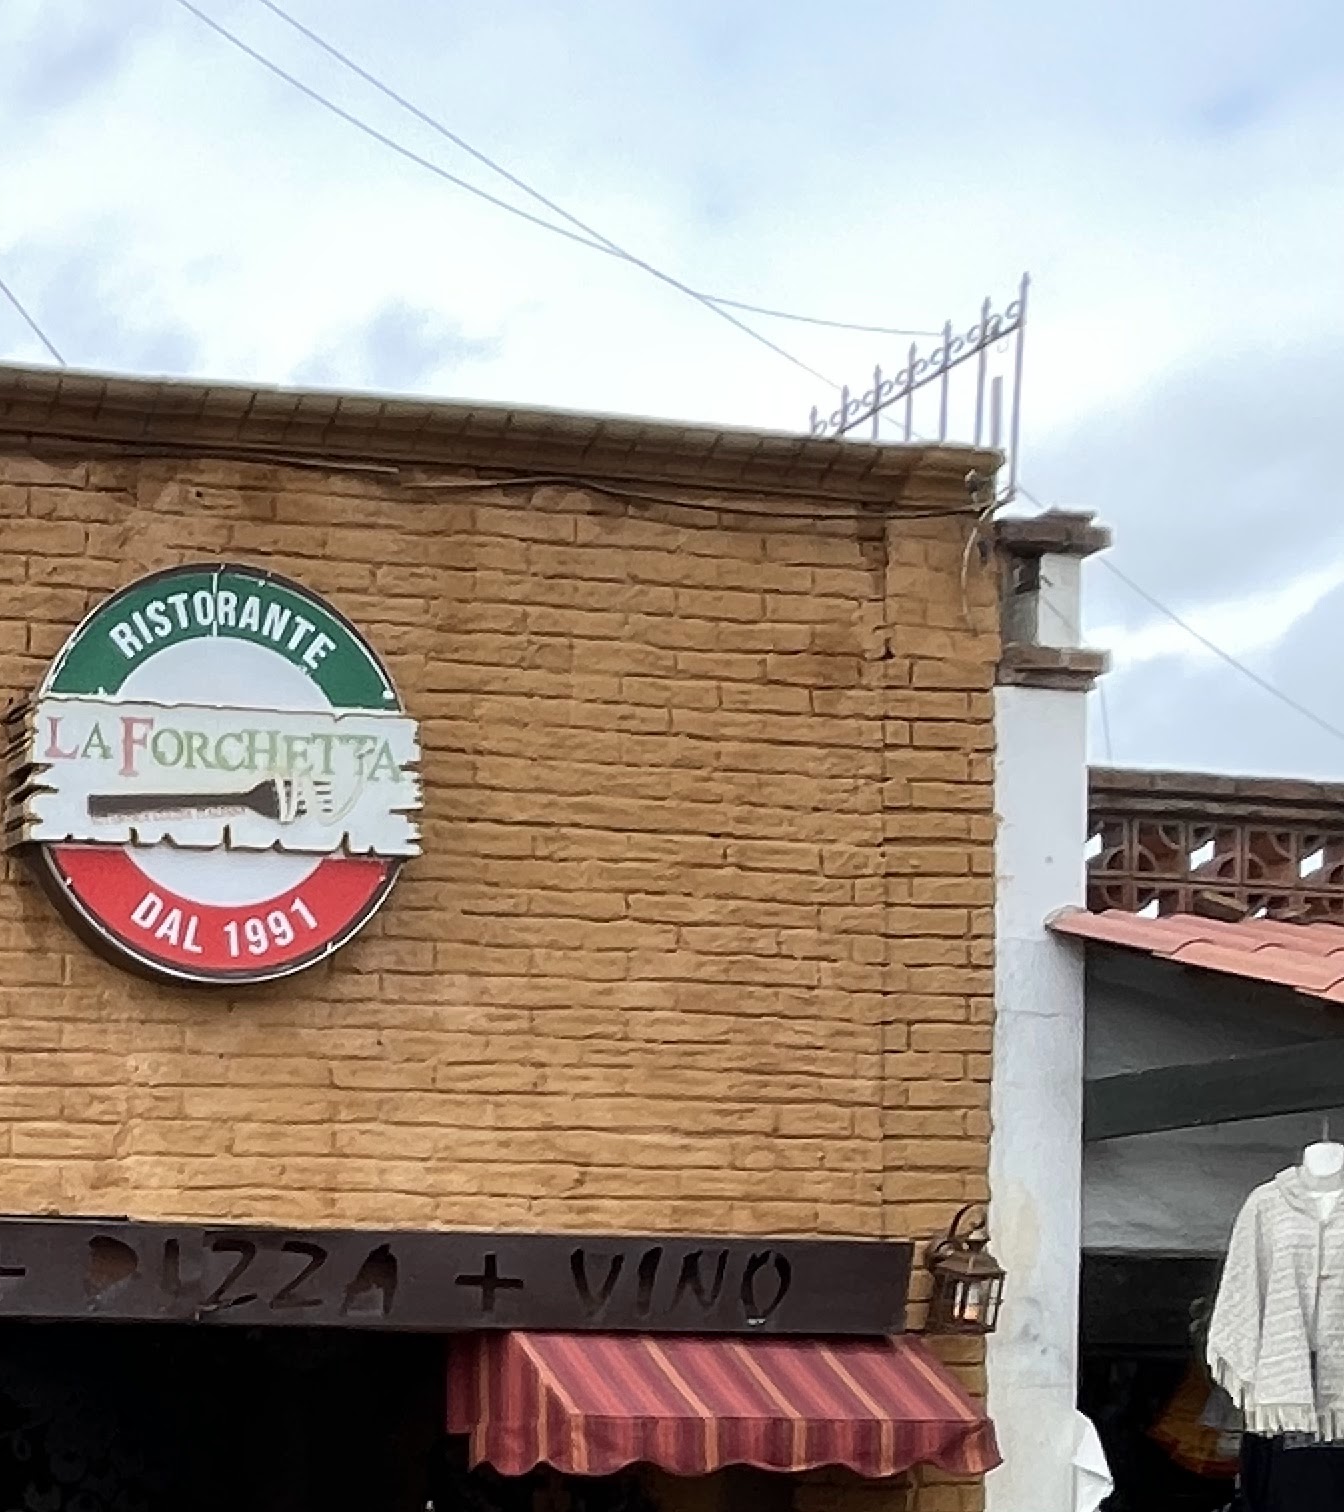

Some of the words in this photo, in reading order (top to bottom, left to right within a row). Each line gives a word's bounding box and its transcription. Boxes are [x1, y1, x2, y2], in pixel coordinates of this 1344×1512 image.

[109, 590, 336, 670] RISTORANTE
[45, 716, 112, 760] LA
[119, 716, 404, 782] FORCHETTA
[131, 892, 203, 954] DAL
[223, 896, 318, 958] 1991
[570, 1246, 791, 1322] VINO
